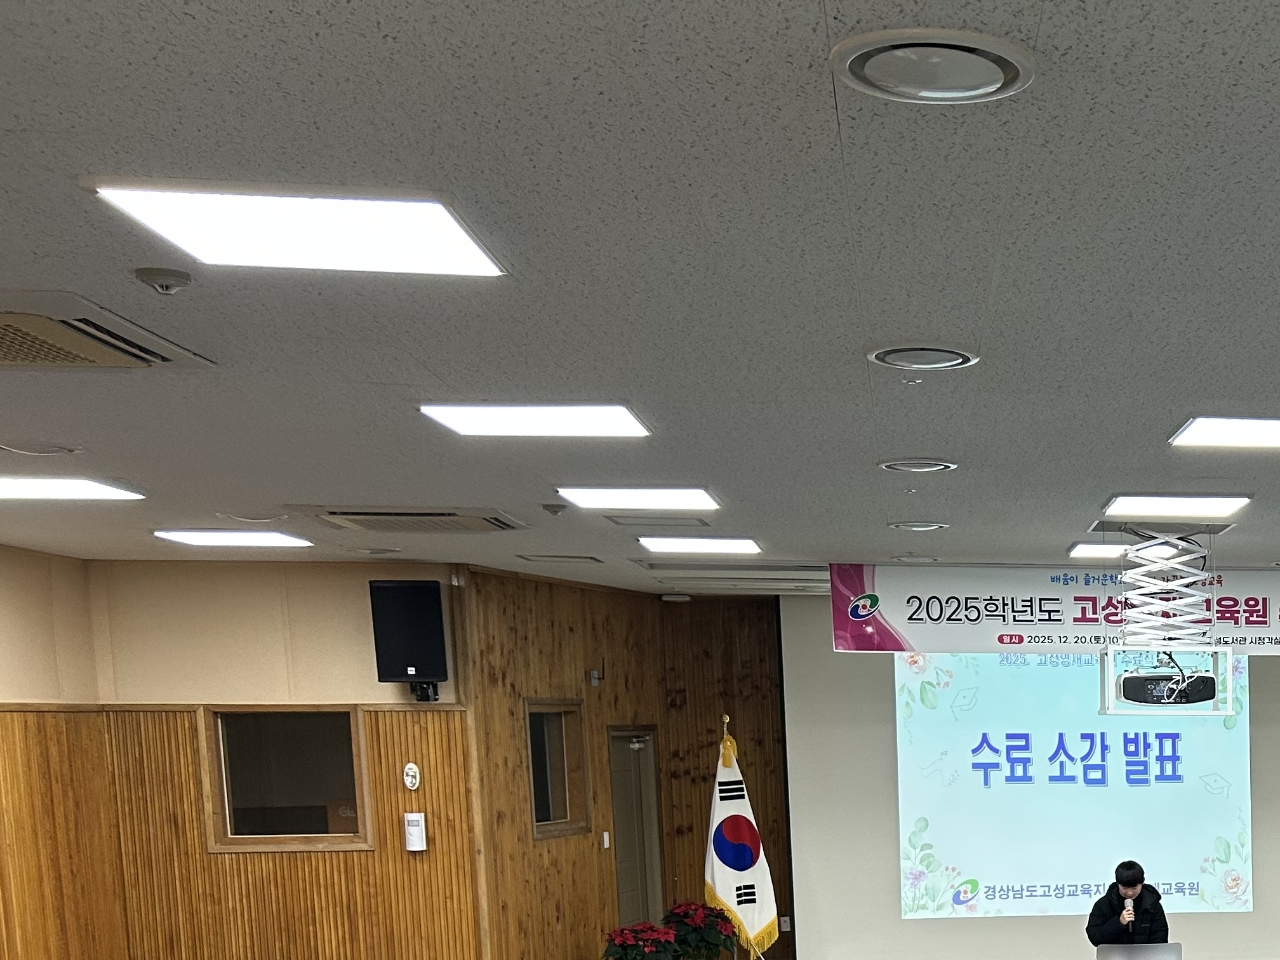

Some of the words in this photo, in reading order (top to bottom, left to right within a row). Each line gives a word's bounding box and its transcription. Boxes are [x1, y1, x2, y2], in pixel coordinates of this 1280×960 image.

[1050, 573, 1078, 586] 배움이
[906, 595, 1063, 624] 2025학년도
[1002, 634, 1020, 644] 일시
[970, 731, 1035, 788] 수료
[1047, 731, 1110, 787] 소감
[1123, 731, 1184, 787] 발표
[983, 882, 1106, 900] 경상남도고성교육지
